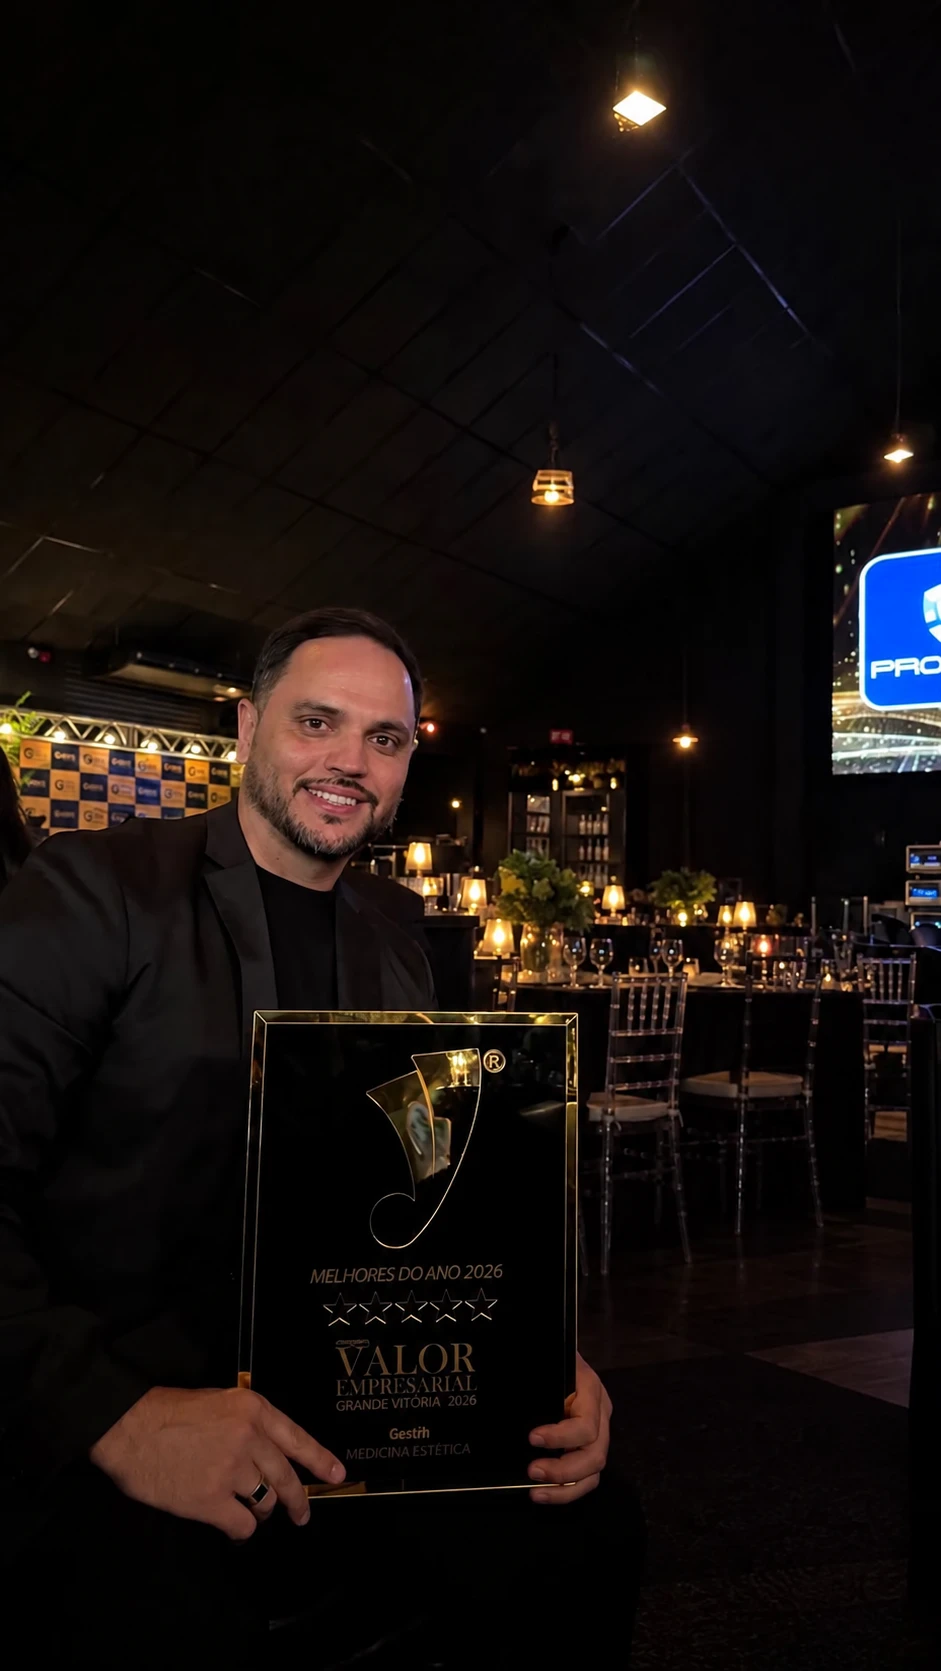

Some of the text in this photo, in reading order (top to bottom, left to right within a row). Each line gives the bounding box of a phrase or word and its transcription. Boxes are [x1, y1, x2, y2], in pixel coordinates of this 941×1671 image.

[871, 655, 941, 680] PRO
[310, 1264, 503, 1284] MELHORES DO ANO 2026
[335, 1342, 476, 1377] VALOR
[336, 1375, 478, 1397] EMPRESARIAL
[336, 1394, 477, 1412] GRANDE VITÓRIA 2026
[346, 1443, 471, 1460] MEDICINA ESTÉTICA
